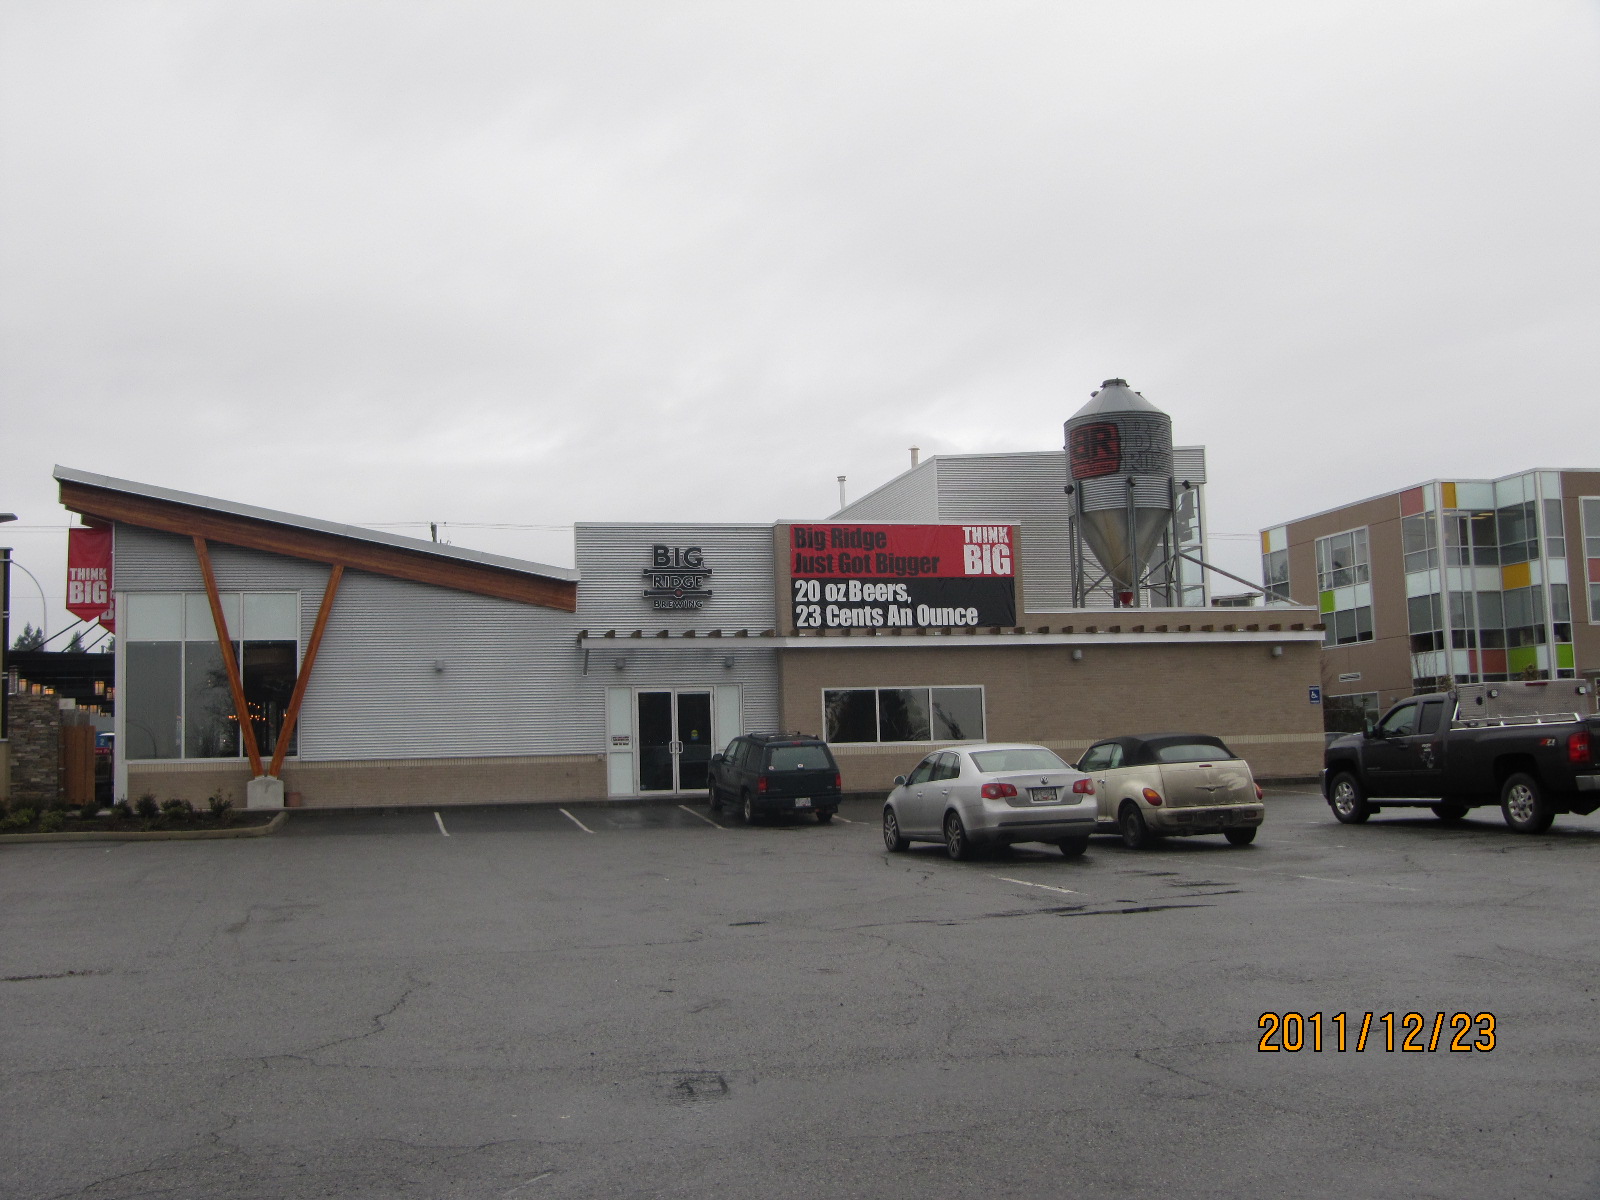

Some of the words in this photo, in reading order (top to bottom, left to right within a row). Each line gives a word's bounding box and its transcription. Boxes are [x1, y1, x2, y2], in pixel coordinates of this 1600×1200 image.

[794, 527, 826, 551] Big
[831, 527, 887, 551] Ridge
[962, 526, 1009, 544] THINK
[652, 545, 704, 568] BIG
[794, 552, 834, 573] Just
[838, 552, 872, 573] Got
[876, 552, 940, 577] Bigger
[963, 544, 1011, 575] BIG
[69, 567, 107, 580] THINK
[652, 575, 704, 588] RIDGE
[69, 580, 107, 604] BIG
[794, 580, 820, 602] 20
[824, 583, 847, 602] oz
[848, 580, 912, 604] Beers,
[653, 599, 704, 609] BREWING
[795, 604, 822, 627] 23
[825, 604, 884, 627] Cents
[887, 604, 913, 626] An
[916, 604, 979, 627] Ounce
